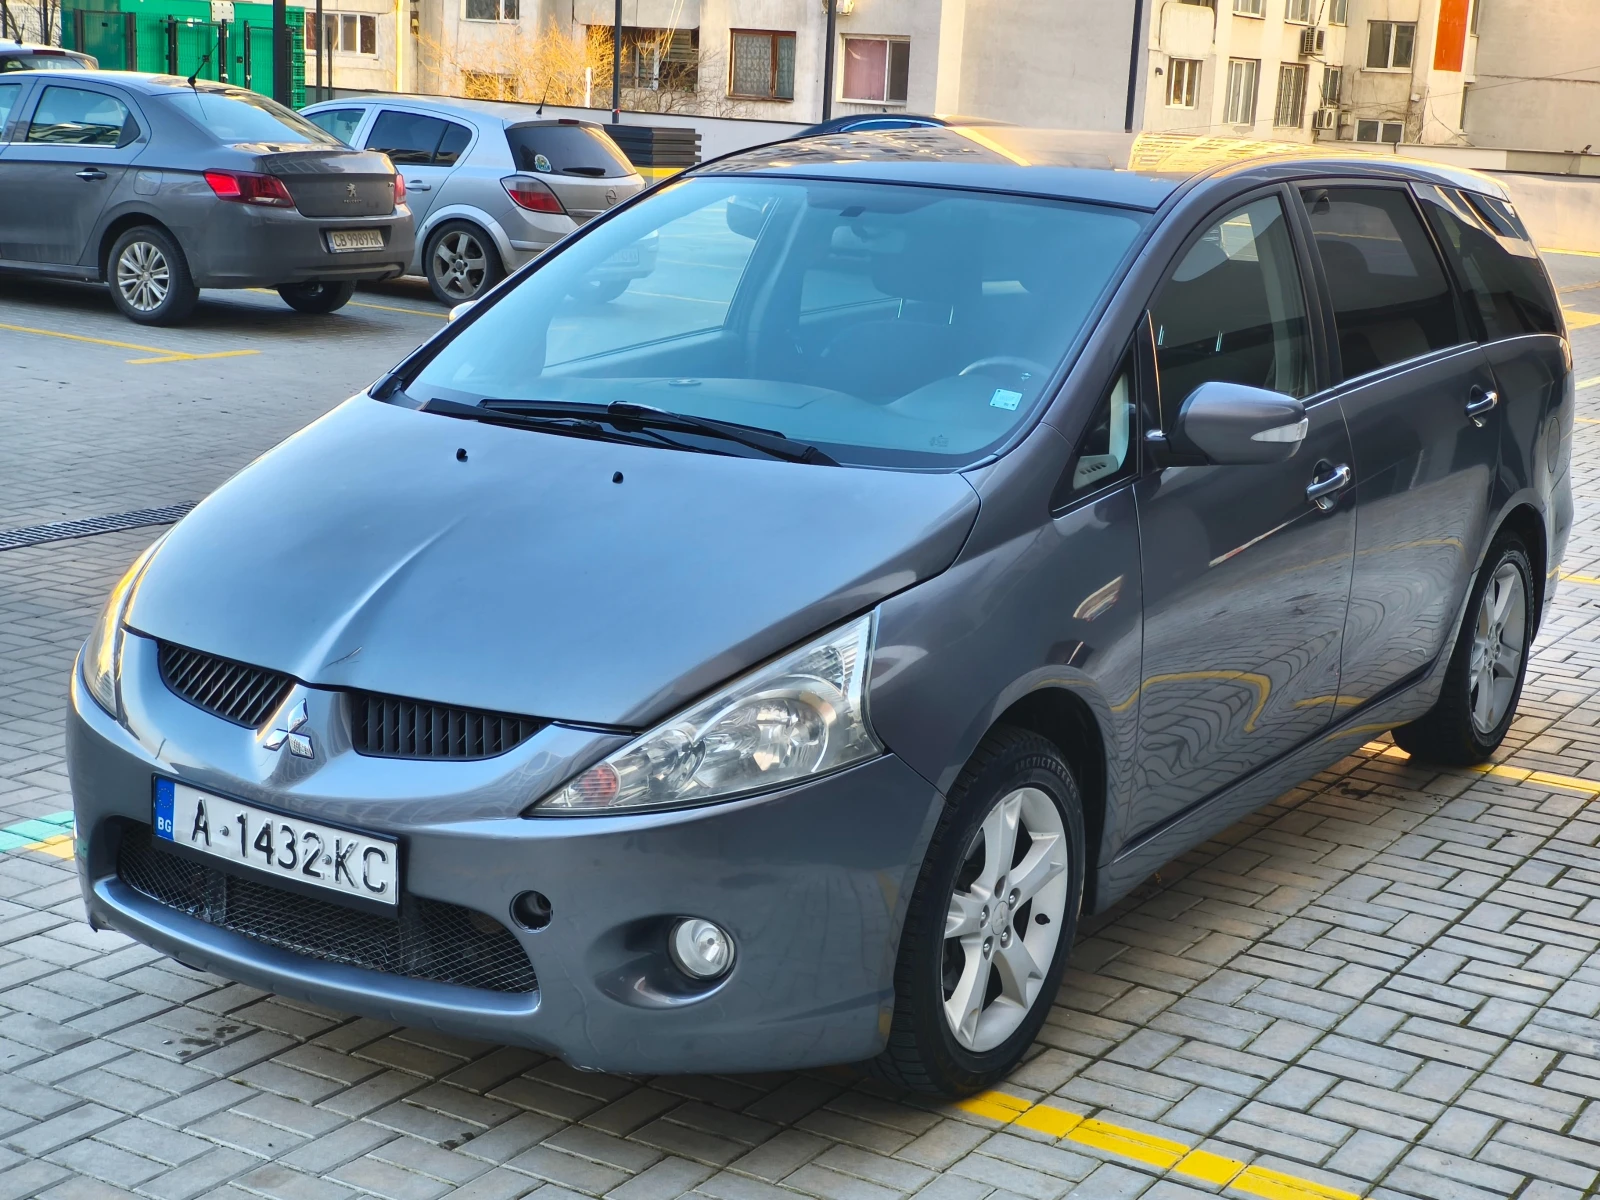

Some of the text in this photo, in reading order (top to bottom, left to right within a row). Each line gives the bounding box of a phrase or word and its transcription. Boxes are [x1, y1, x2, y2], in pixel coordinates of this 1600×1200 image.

[333, 233, 347, 247] CB
[157, 816, 172, 833] BG
[191, 797, 389, 895] A 1432 KC
